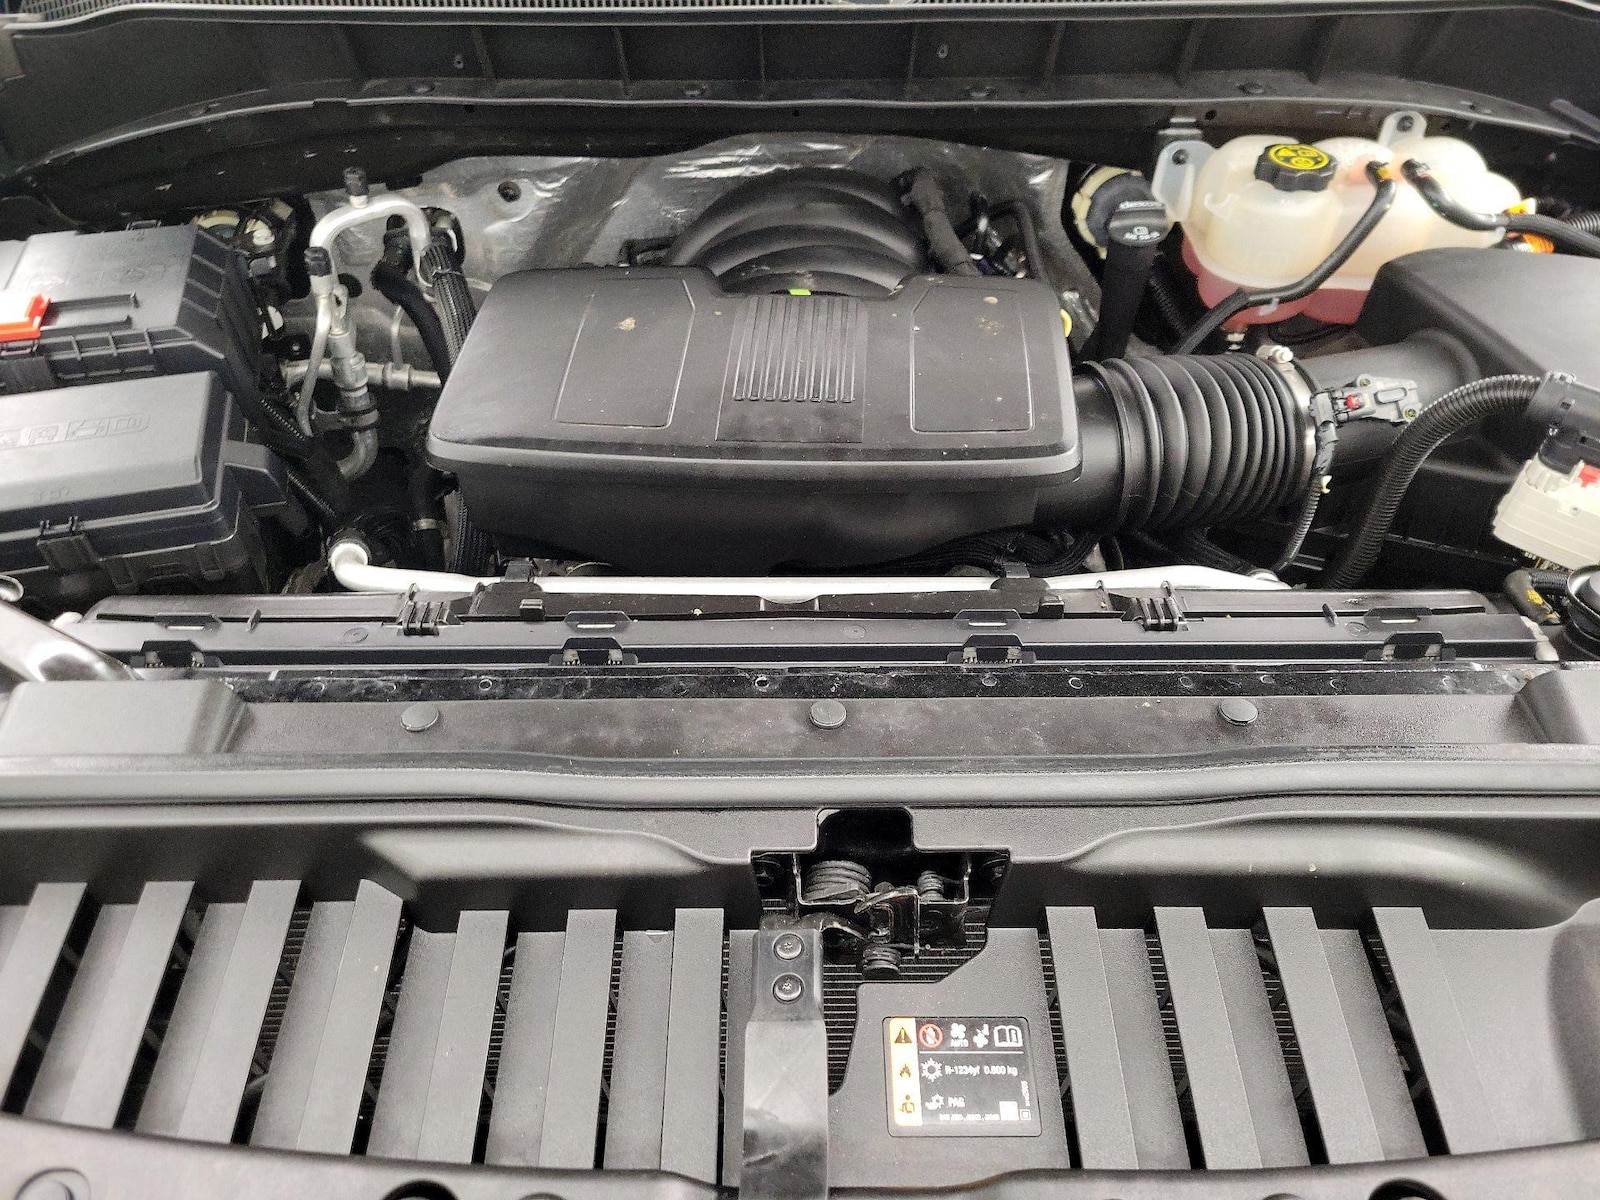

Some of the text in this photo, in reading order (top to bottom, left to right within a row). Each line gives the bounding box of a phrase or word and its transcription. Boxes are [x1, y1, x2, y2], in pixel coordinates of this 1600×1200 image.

[950, 1039, 969, 1047] AUTO
[944, 1065, 980, 1076] R-1234yf
[1007, 1065, 1018, 1077] kg
[947, 1096, 966, 1108] PAG
